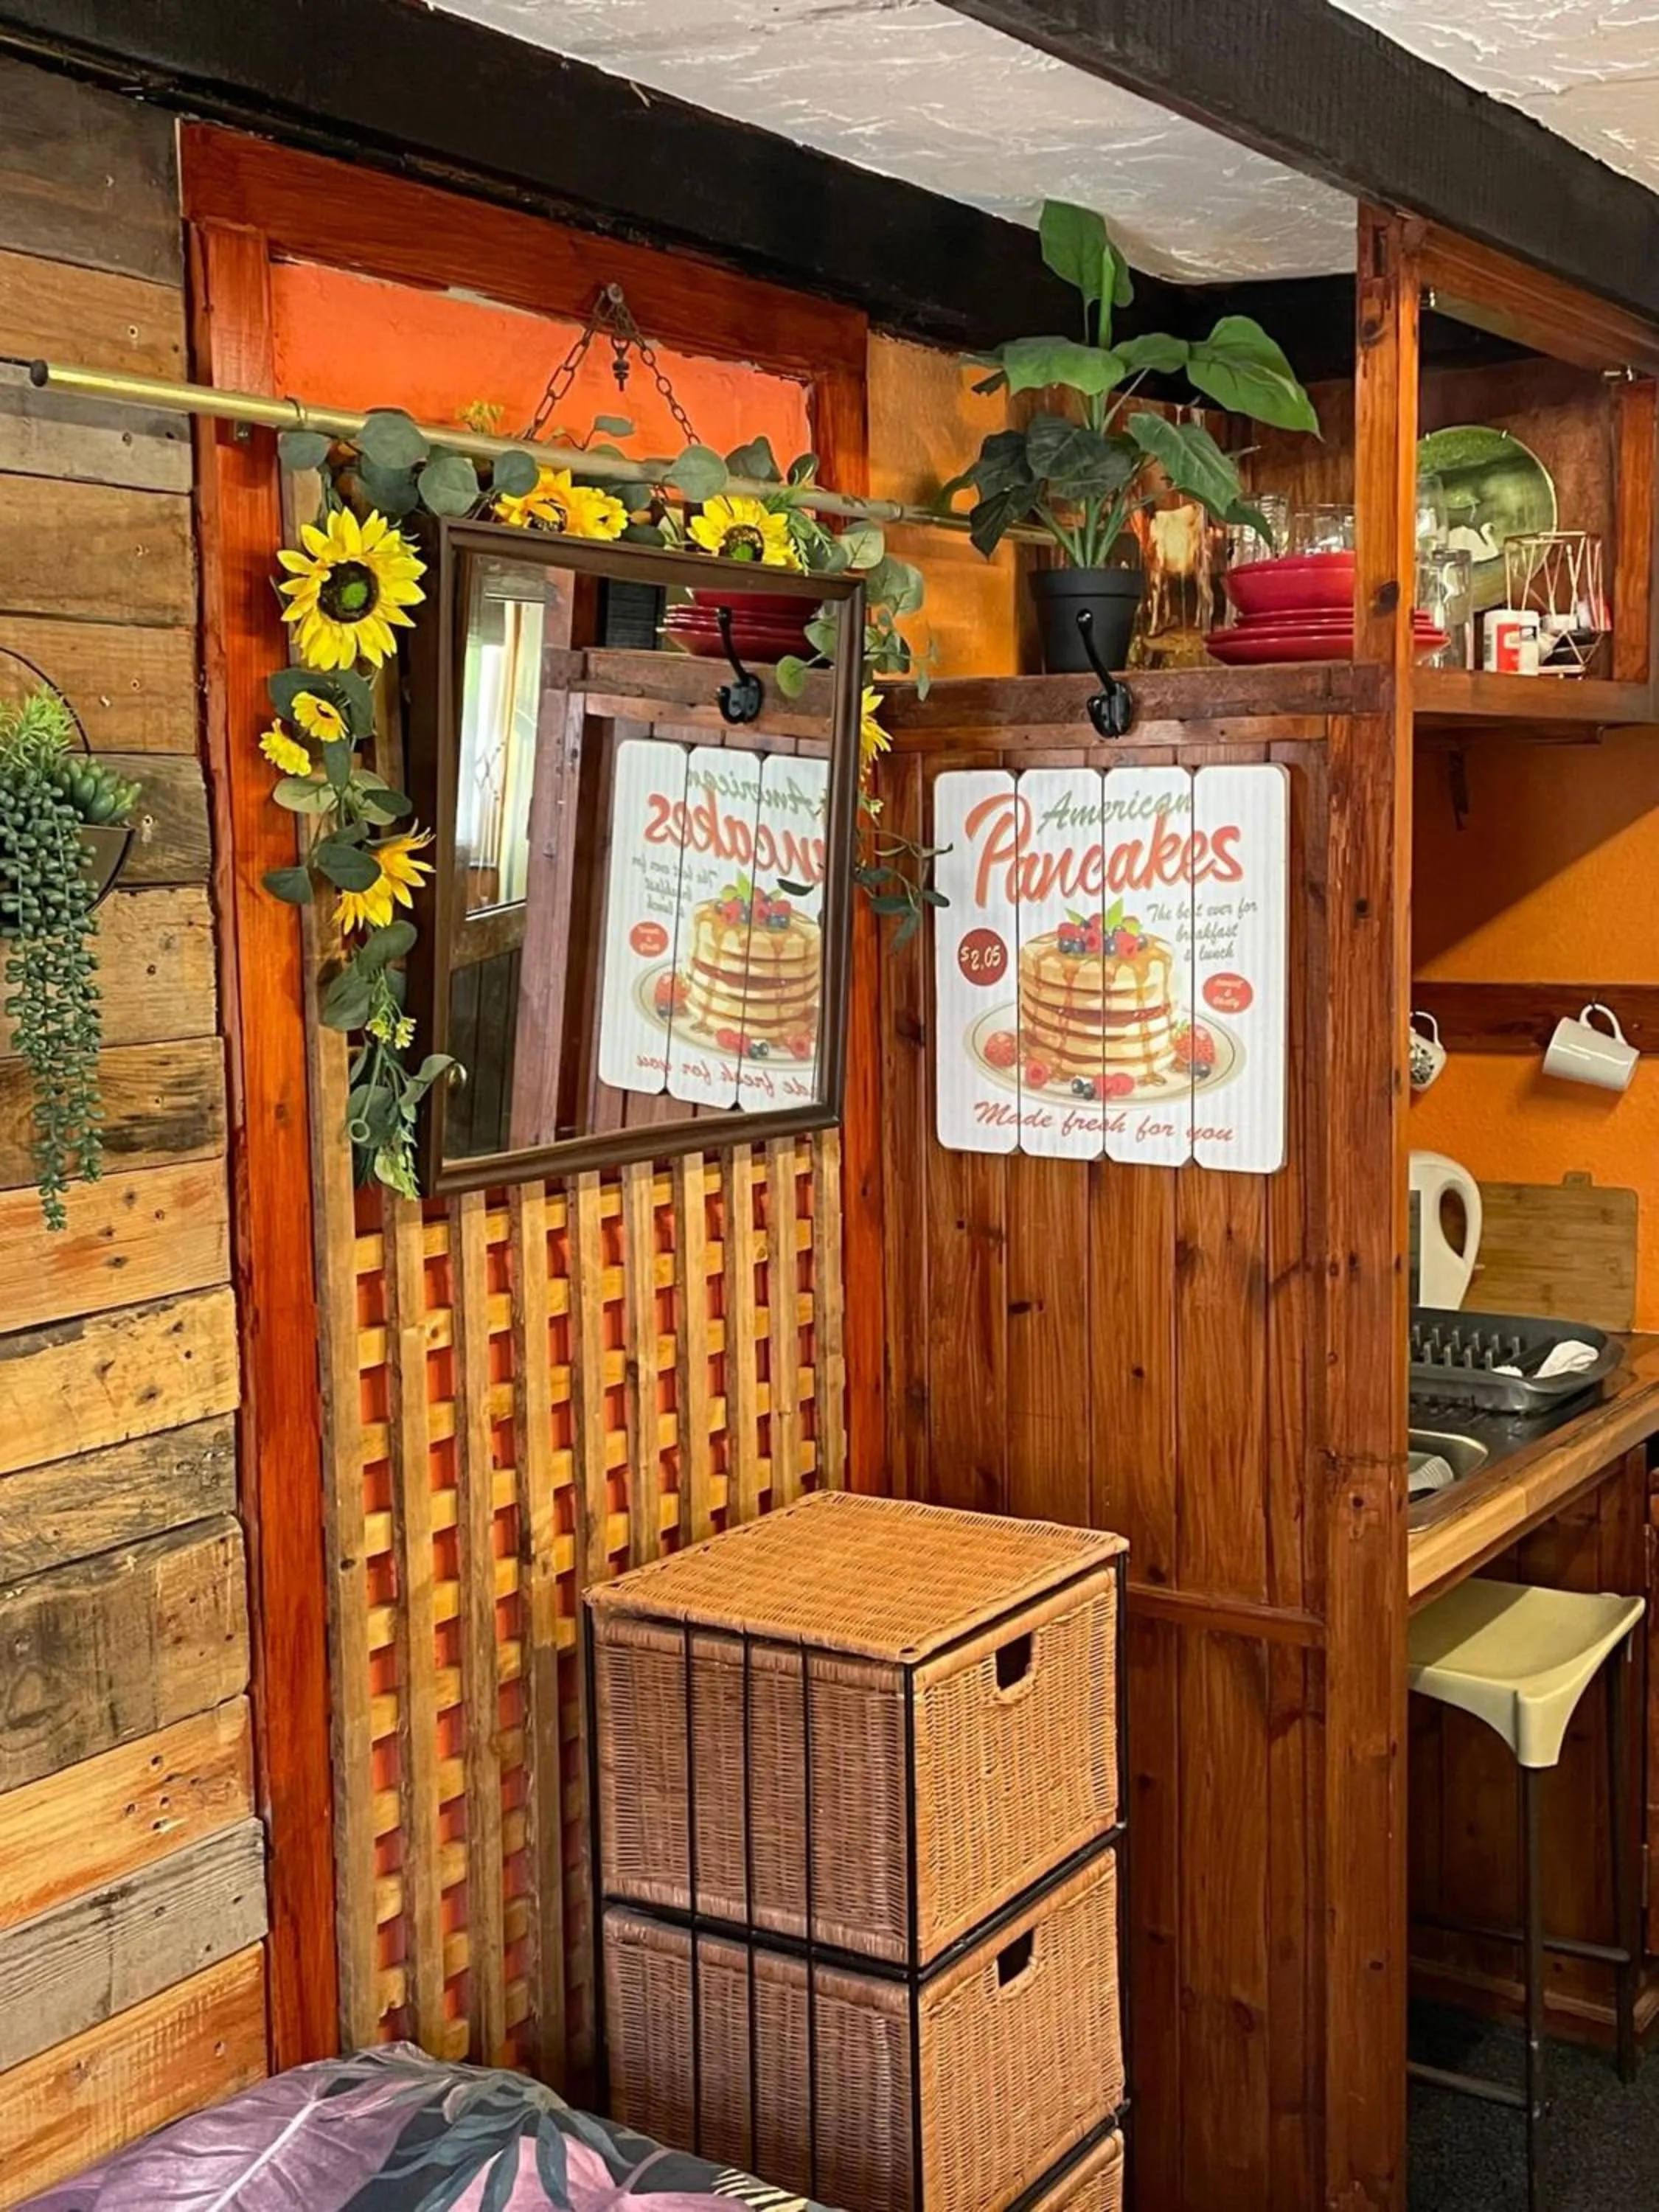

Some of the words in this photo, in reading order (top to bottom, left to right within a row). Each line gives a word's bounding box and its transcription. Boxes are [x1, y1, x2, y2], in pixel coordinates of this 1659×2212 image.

[1037, 790, 1192, 835] American
[964, 793, 1245, 908] Pancakes
[1147, 902, 1172, 922] The
[1176, 900, 1203, 920] bet
[1238, 897, 1258, 920] for
[1175, 922, 1239, 945] brakfast
[960, 945, 1001, 970] $2.05
[975, 1101, 1053, 1127] Made
[1061, 1110, 1127, 1137] fresh
[1135, 1115, 1178, 1143] for
[1186, 1125, 1235, 1143] you
